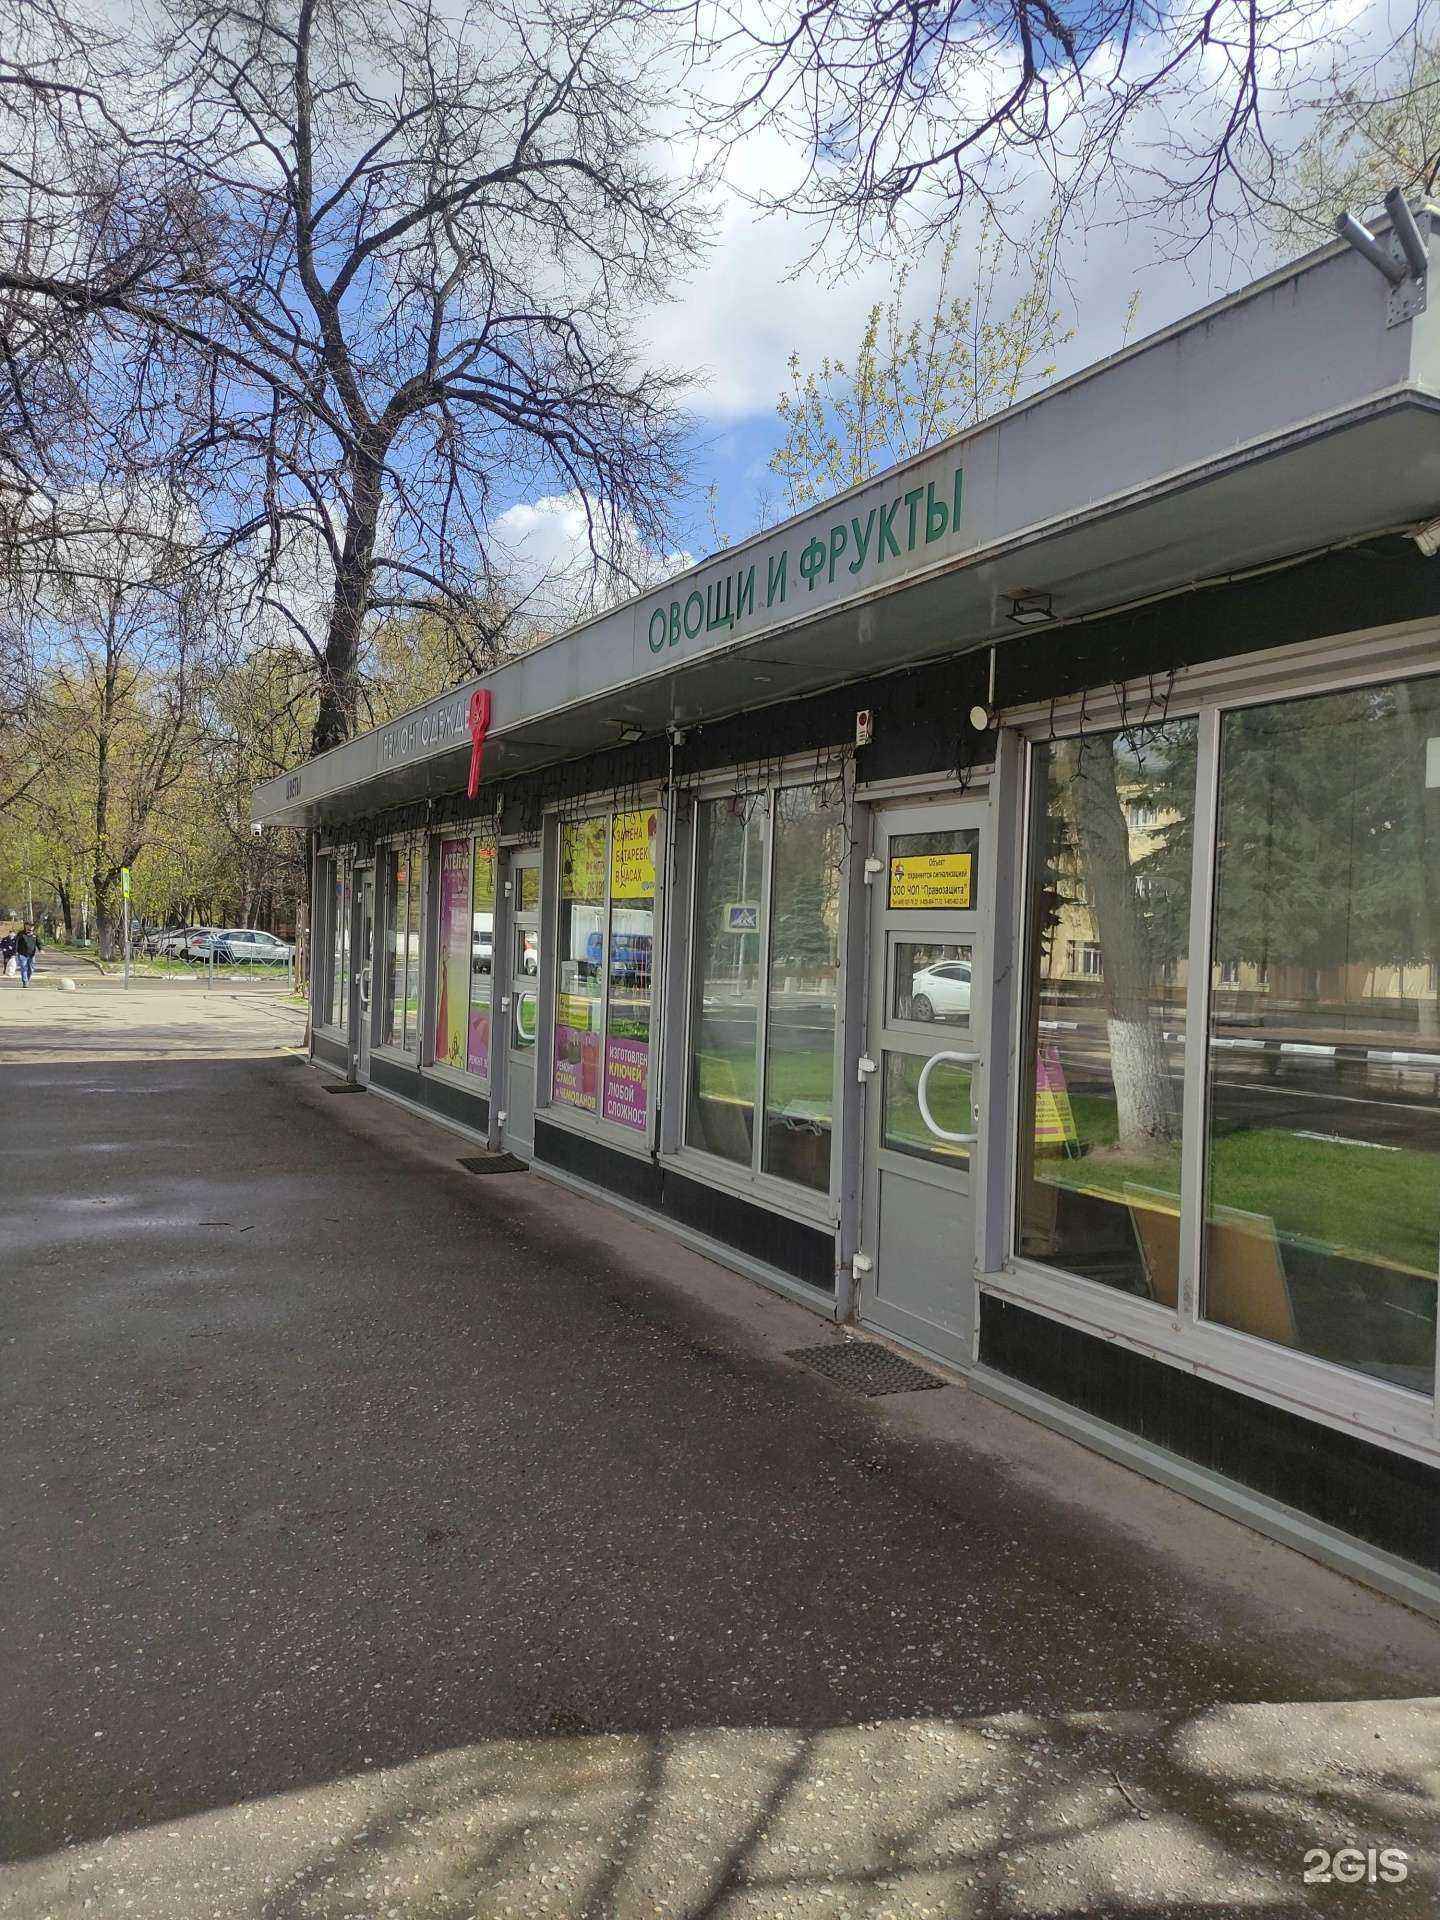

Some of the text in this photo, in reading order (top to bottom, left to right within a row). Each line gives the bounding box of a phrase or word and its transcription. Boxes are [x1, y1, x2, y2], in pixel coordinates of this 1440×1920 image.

[648, 467, 963, 654] ОВОЩИ И ФРУКТЫ
[892, 885, 906, 896] ООО
[608, 1062, 642, 1083] КЛЮЧЕЙ
[607, 1081, 635, 1103] ЛЮБОЙ
